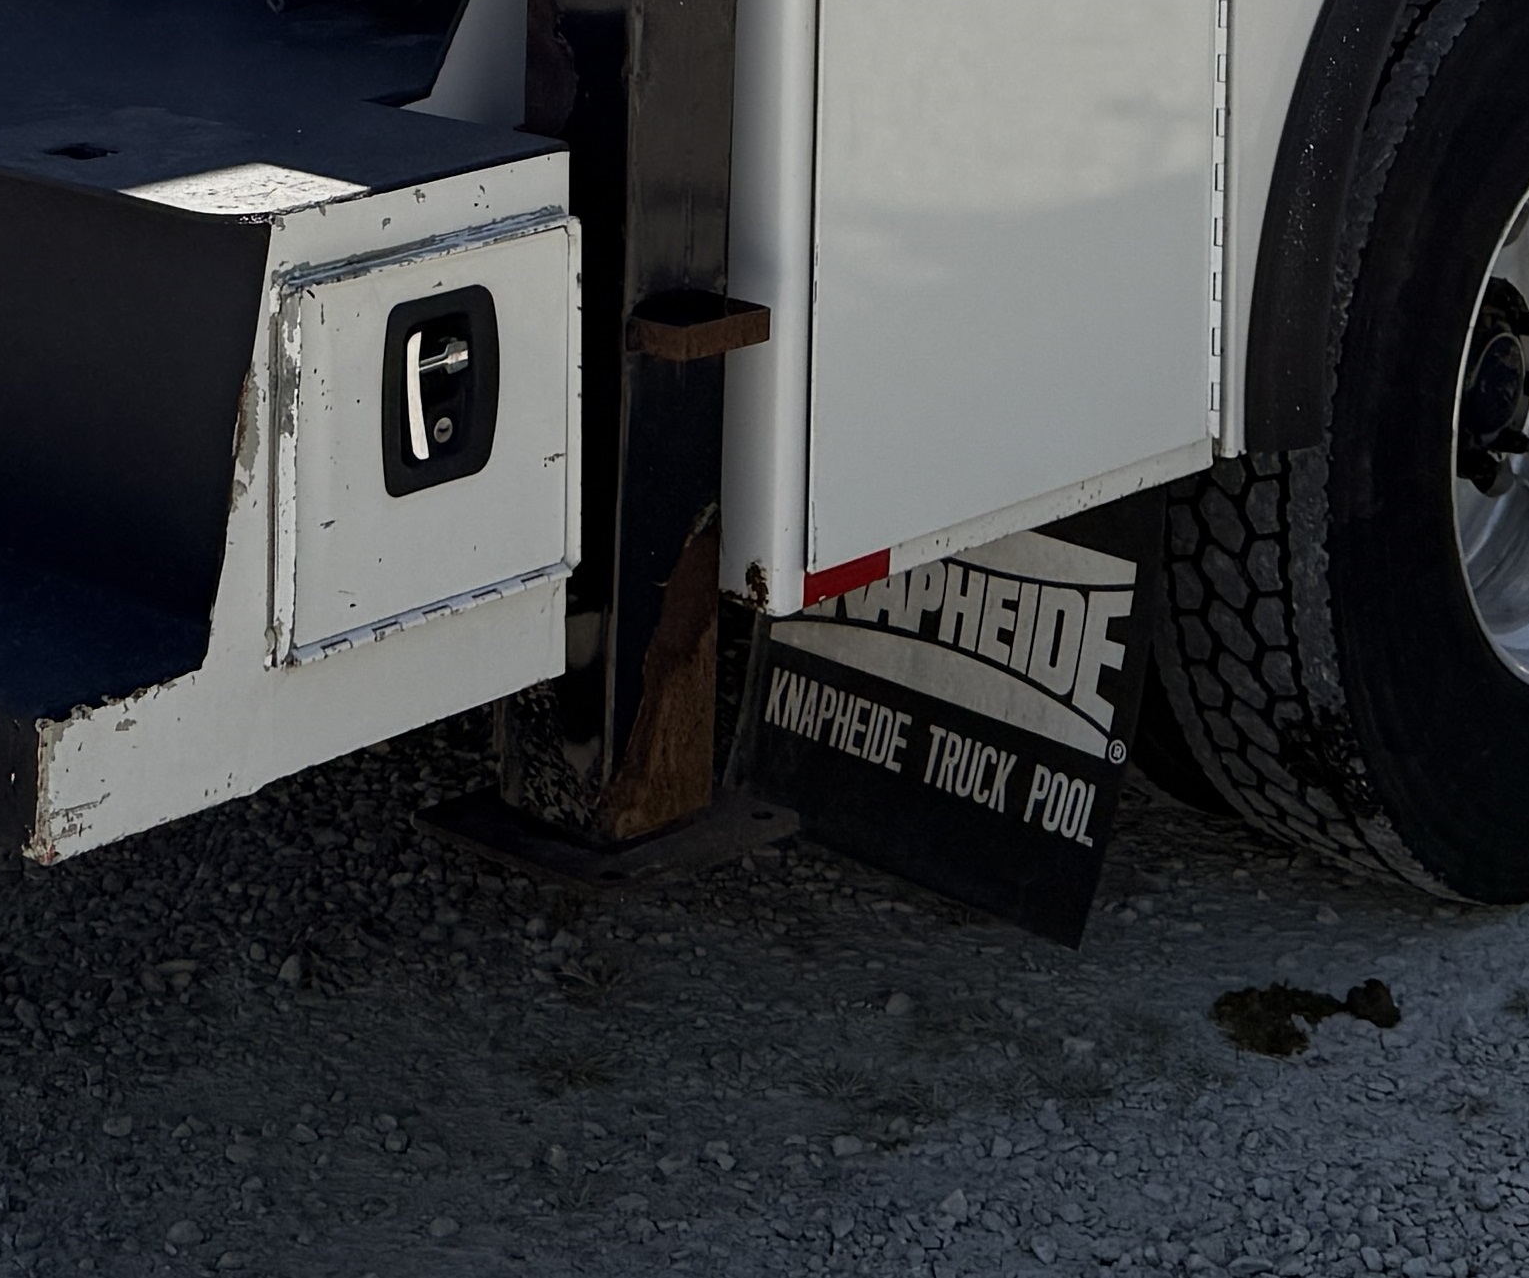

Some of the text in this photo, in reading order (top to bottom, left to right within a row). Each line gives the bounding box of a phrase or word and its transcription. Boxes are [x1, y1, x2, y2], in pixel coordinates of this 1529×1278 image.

[803, 558, 1135, 732] APHEIDE
[764, 666, 1097, 848] KNAPHEIDE TRUCK POOL
